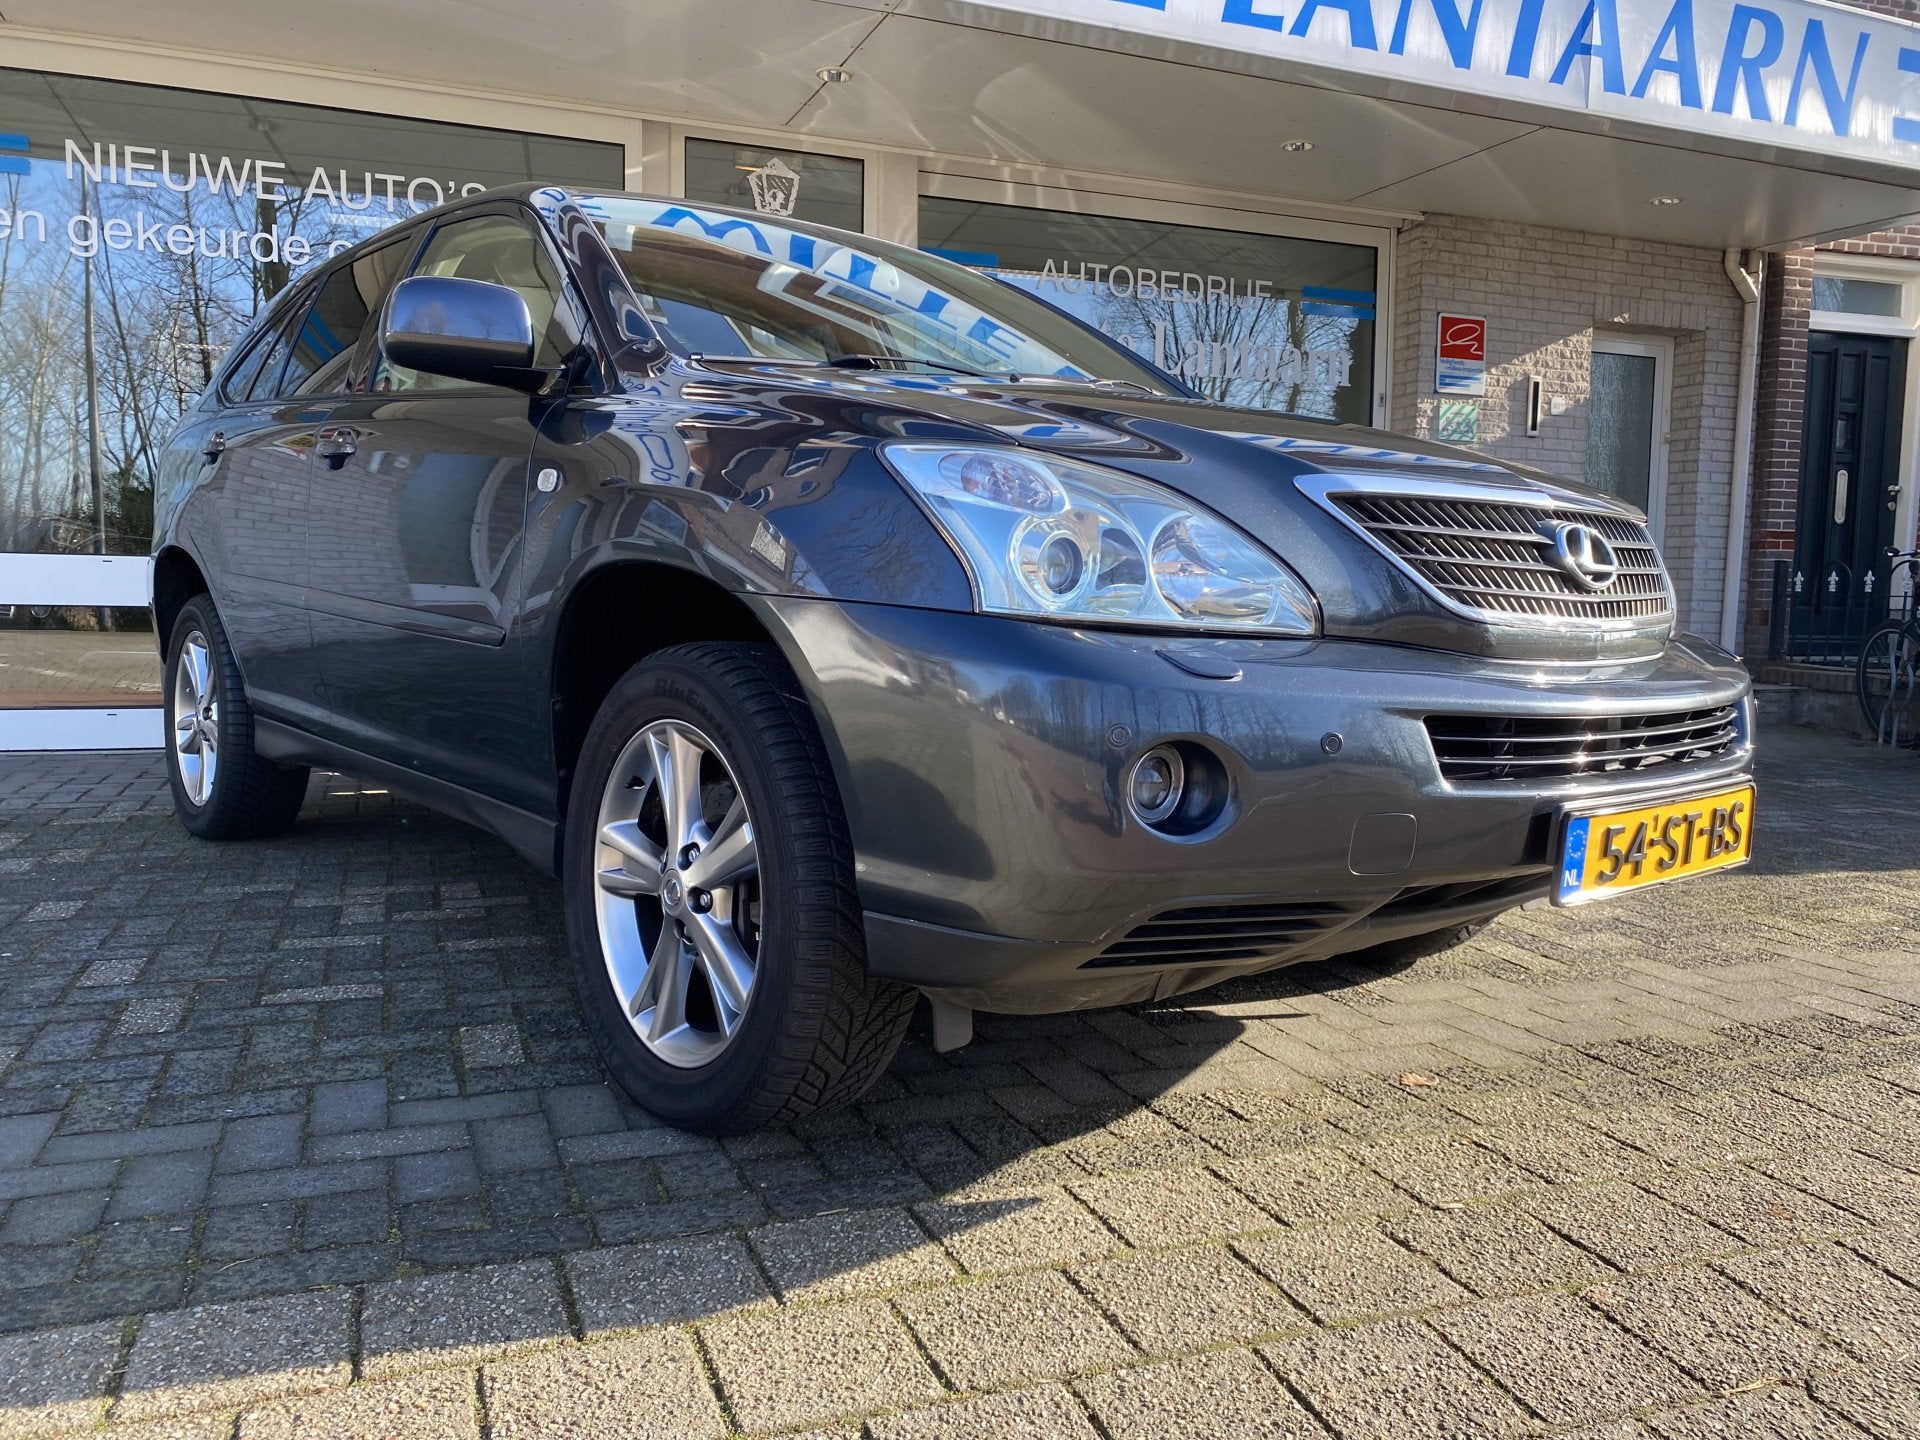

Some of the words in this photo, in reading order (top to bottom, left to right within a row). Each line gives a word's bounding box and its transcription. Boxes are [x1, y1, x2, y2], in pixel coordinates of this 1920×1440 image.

[1221, 0, 1871, 138] NTAARN
[64, 138, 287, 202] NIEUWE
[67, 211, 311, 266] gekeurde
[1036, 258, 1274, 309] AUTOBEDRIJF
[1154, 319, 1352, 387] Lantaarn
[1597, 801, 1744, 884] 54-ST-BS
[1563, 869, 1580, 888] NL
